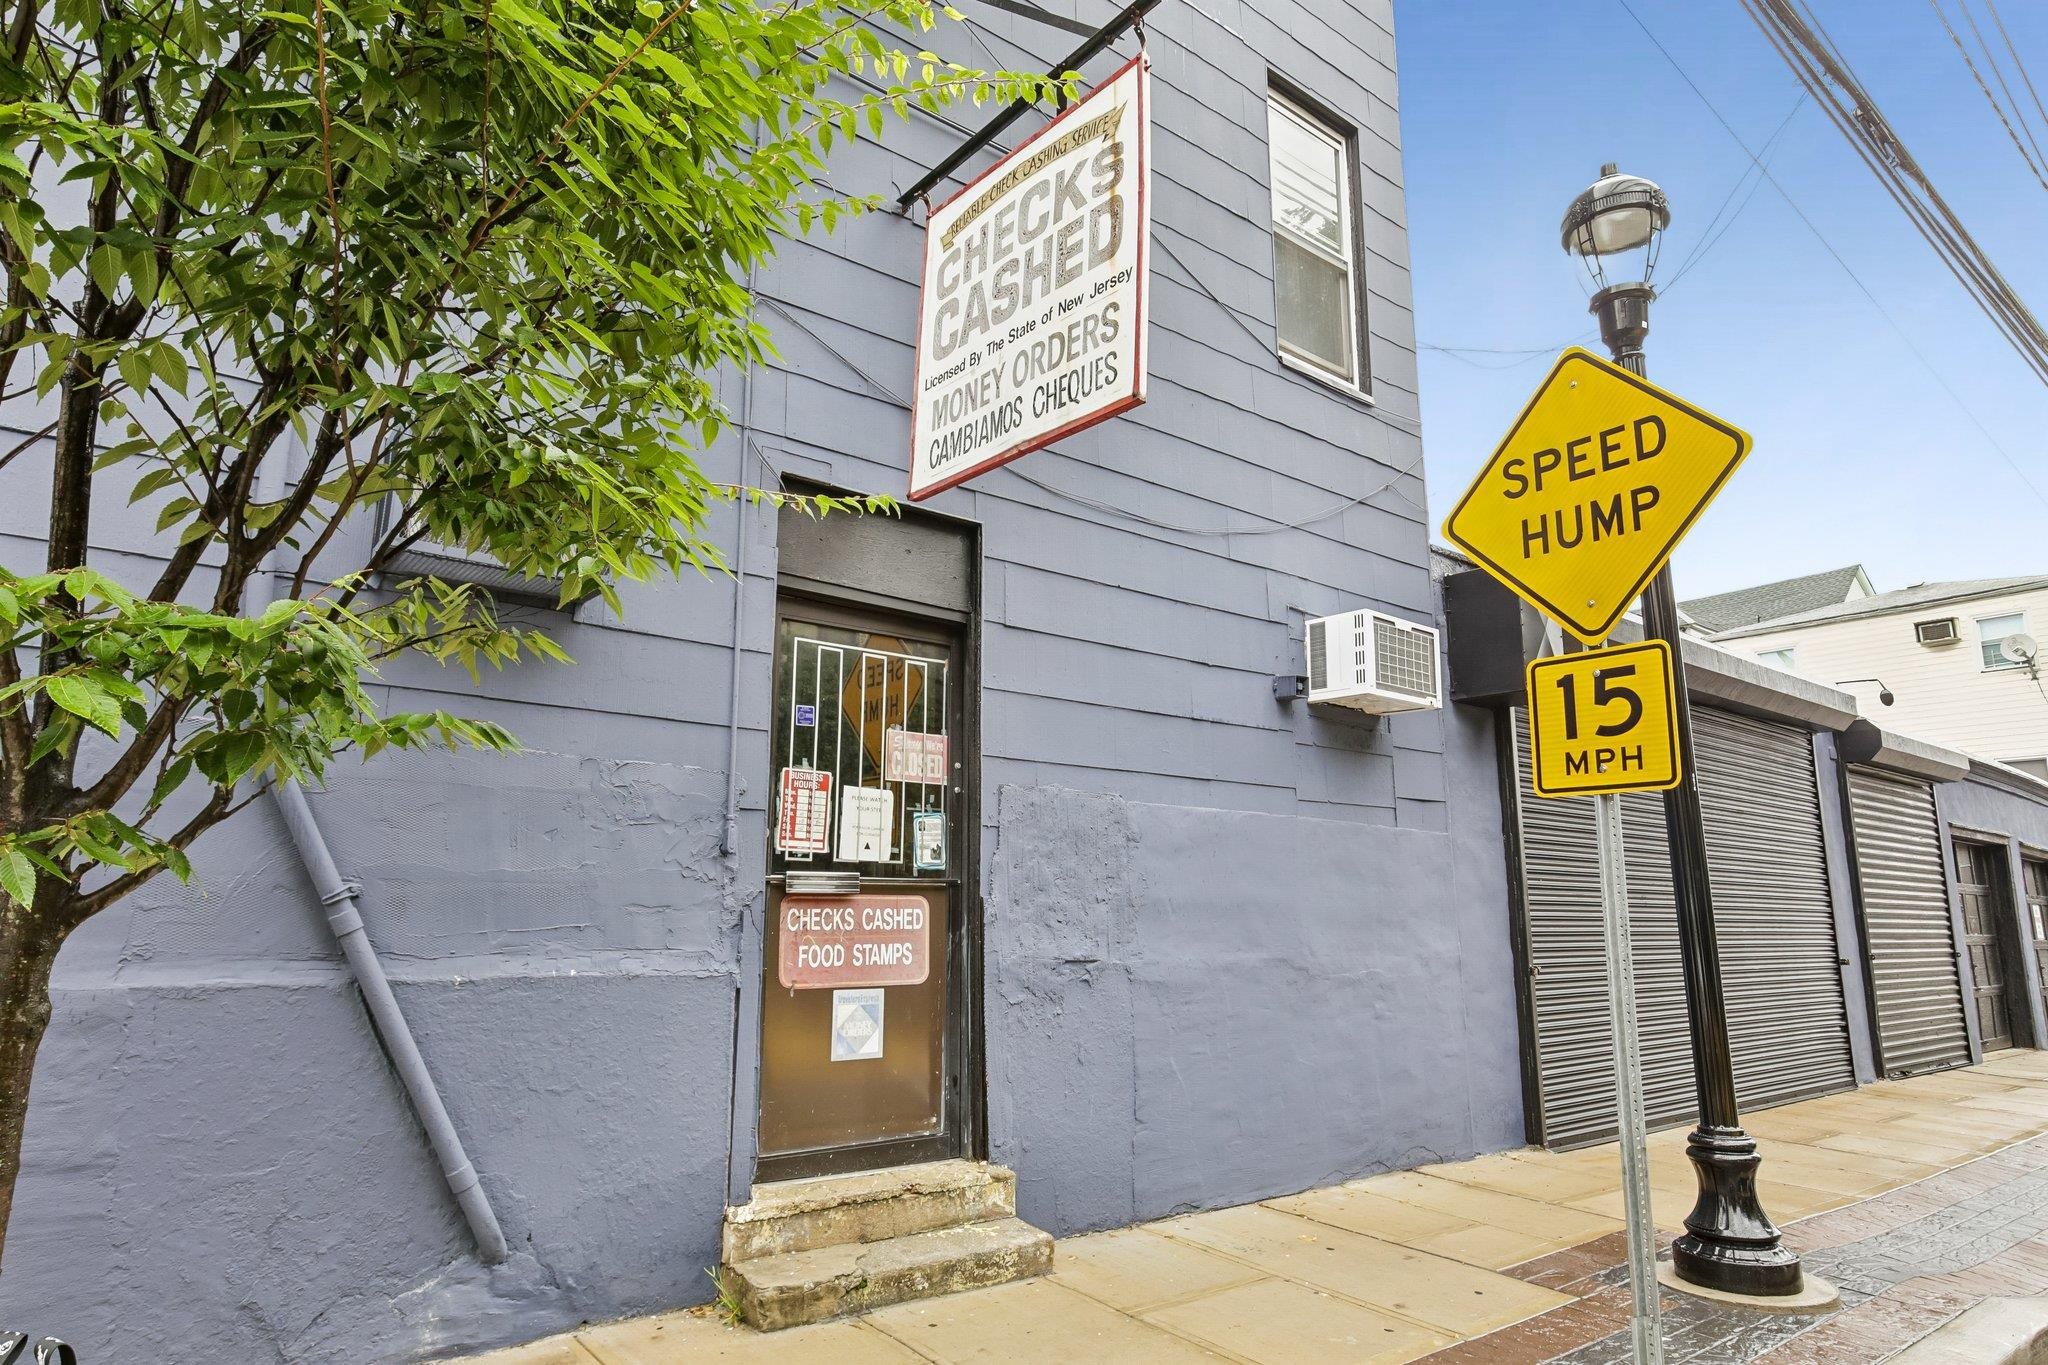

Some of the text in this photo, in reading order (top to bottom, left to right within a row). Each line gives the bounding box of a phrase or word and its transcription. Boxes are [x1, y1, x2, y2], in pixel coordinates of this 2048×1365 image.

[990, 167, 1020, 201] CHECK
[1023, 138, 1068, 177] CASHING
[1072, 116, 1110, 149] SERVICE
[936, 140, 1125, 301] CHECKS
[932, 194, 1124, 362] CASHED
[924, 265, 1134, 392] Licensed By The State of New Jersey
[931, 301, 1120, 431] MONEY ORDERS
[929, 350, 1118, 469] CAMBIAMOS CHEQUES
[1502, 414, 1666, 499] SPEED
[1521, 485, 1660, 559] HUMP
[1556, 664, 1643, 741] 15
[1565, 745, 1643, 776] MPH
[787, 908, 923, 932] CHECKS CASHED
[798, 943, 913, 968] FOOD STAMPS
